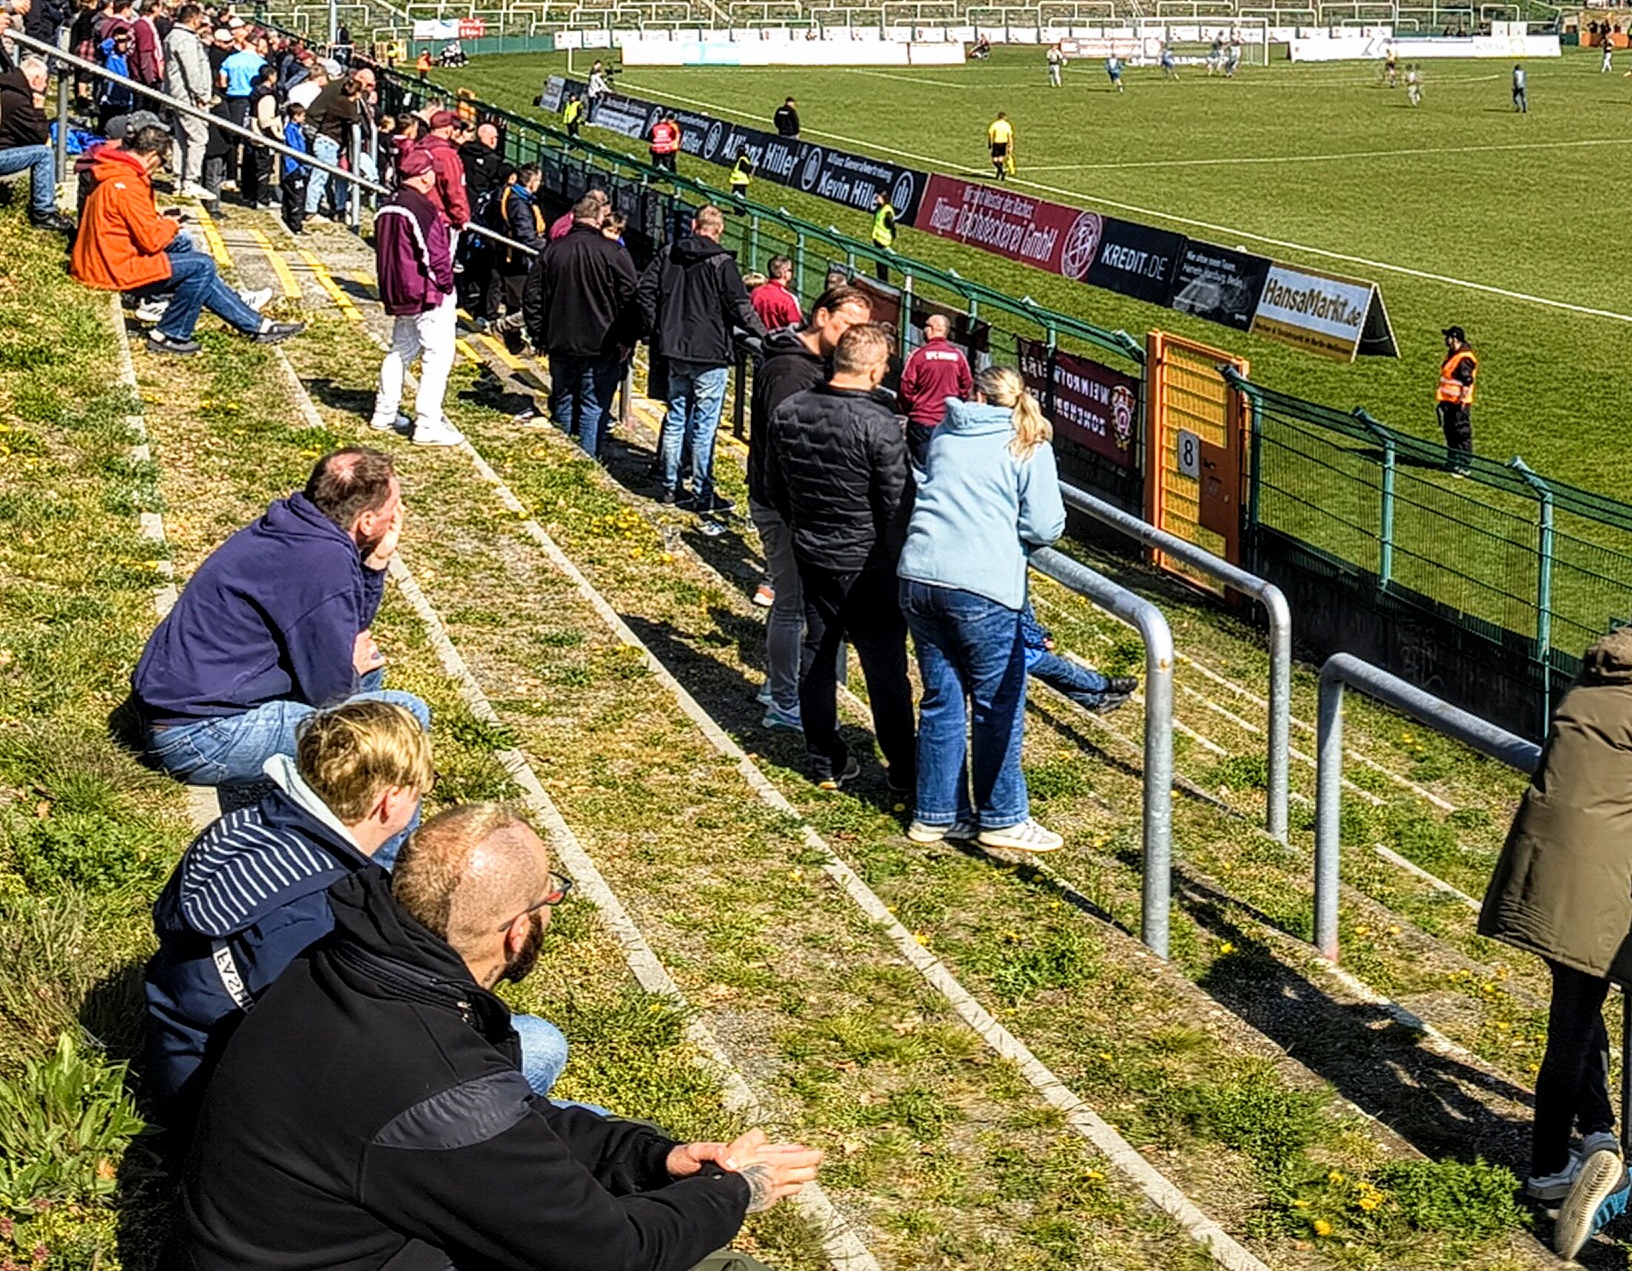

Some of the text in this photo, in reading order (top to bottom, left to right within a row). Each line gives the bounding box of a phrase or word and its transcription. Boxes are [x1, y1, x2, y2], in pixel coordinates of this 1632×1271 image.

[761, 142, 799, 177] Hiller
[816, 170, 879, 212] Kevin Hille
[1020, 223, 1060, 262] GmbH
[1262, 277, 1362, 327] HansaMarkt.de
[1183, 439, 1194, 468] 8
